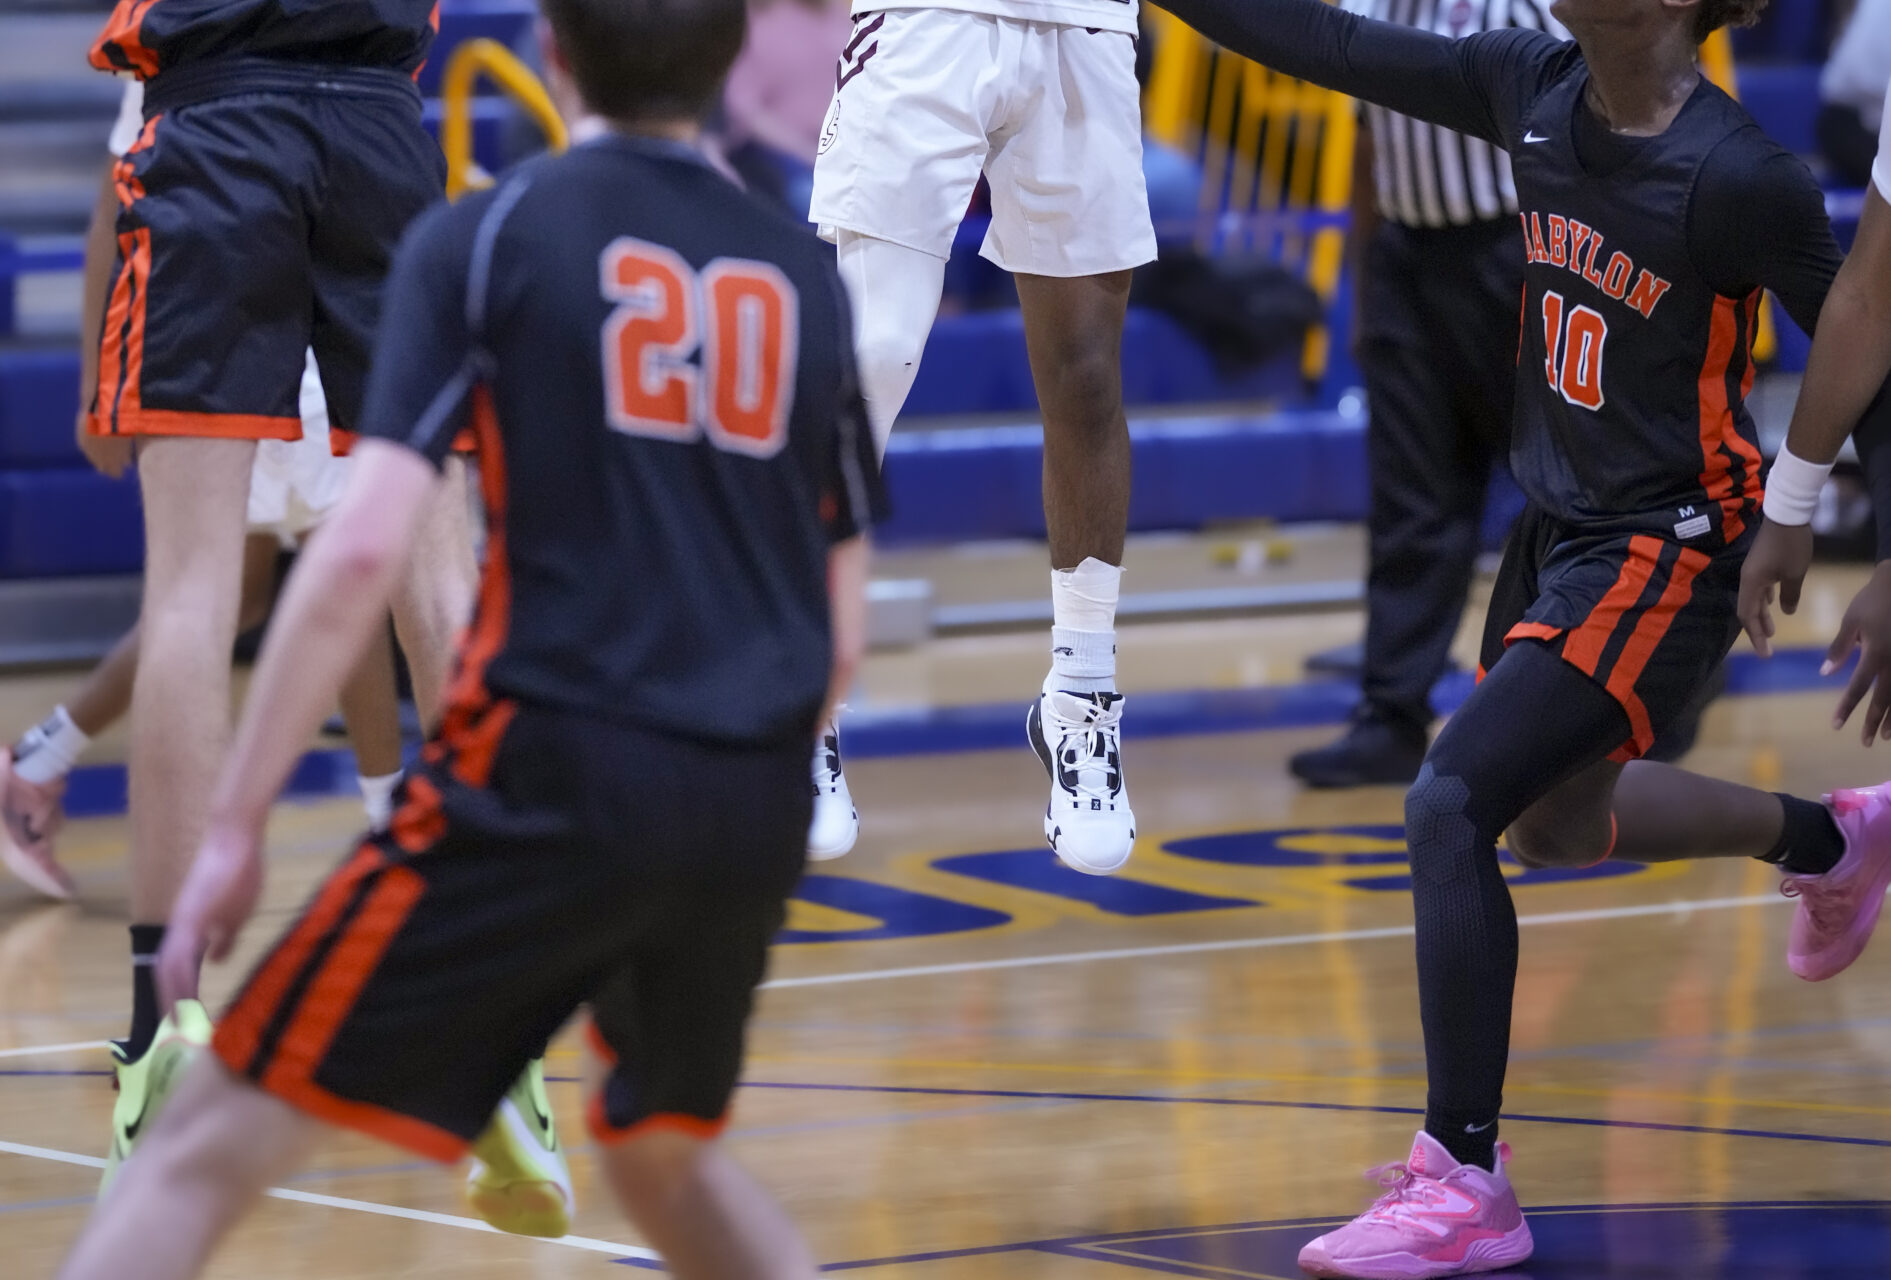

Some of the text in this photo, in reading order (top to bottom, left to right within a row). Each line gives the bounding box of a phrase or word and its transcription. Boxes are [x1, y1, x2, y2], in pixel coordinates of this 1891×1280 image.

[598, 235, 799, 460] 20
[1542, 290, 1608, 411] 10
[1678, 505, 1696, 518] M
